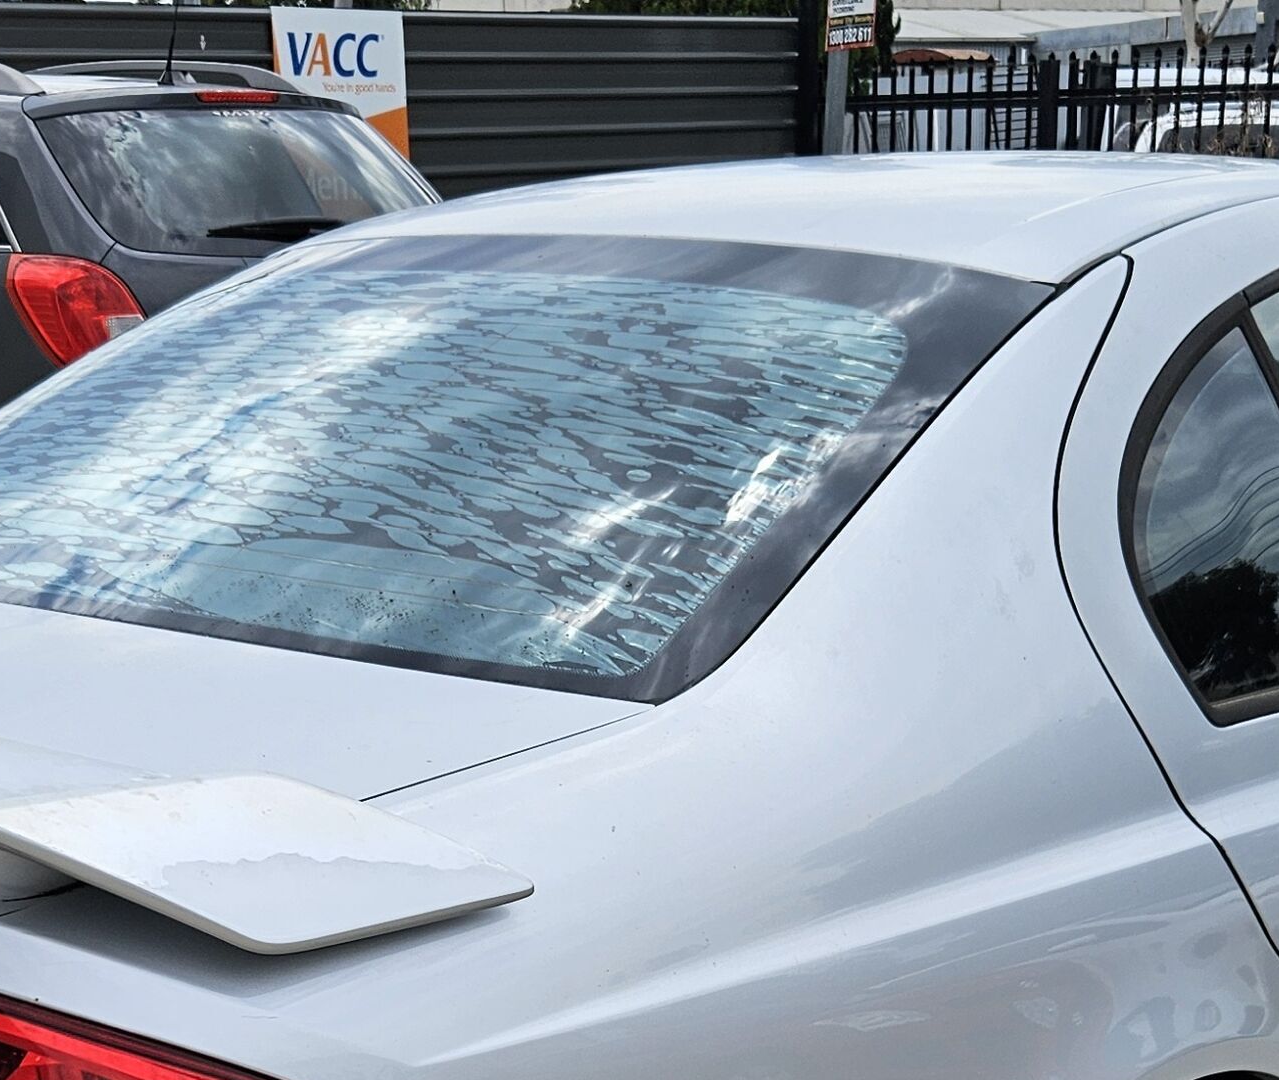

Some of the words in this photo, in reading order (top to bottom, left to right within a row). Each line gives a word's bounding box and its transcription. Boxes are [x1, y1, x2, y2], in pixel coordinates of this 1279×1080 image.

[287, 32, 380, 77] VACC
[355, 83, 374, 95] good
[375, 83, 397, 93] hands
